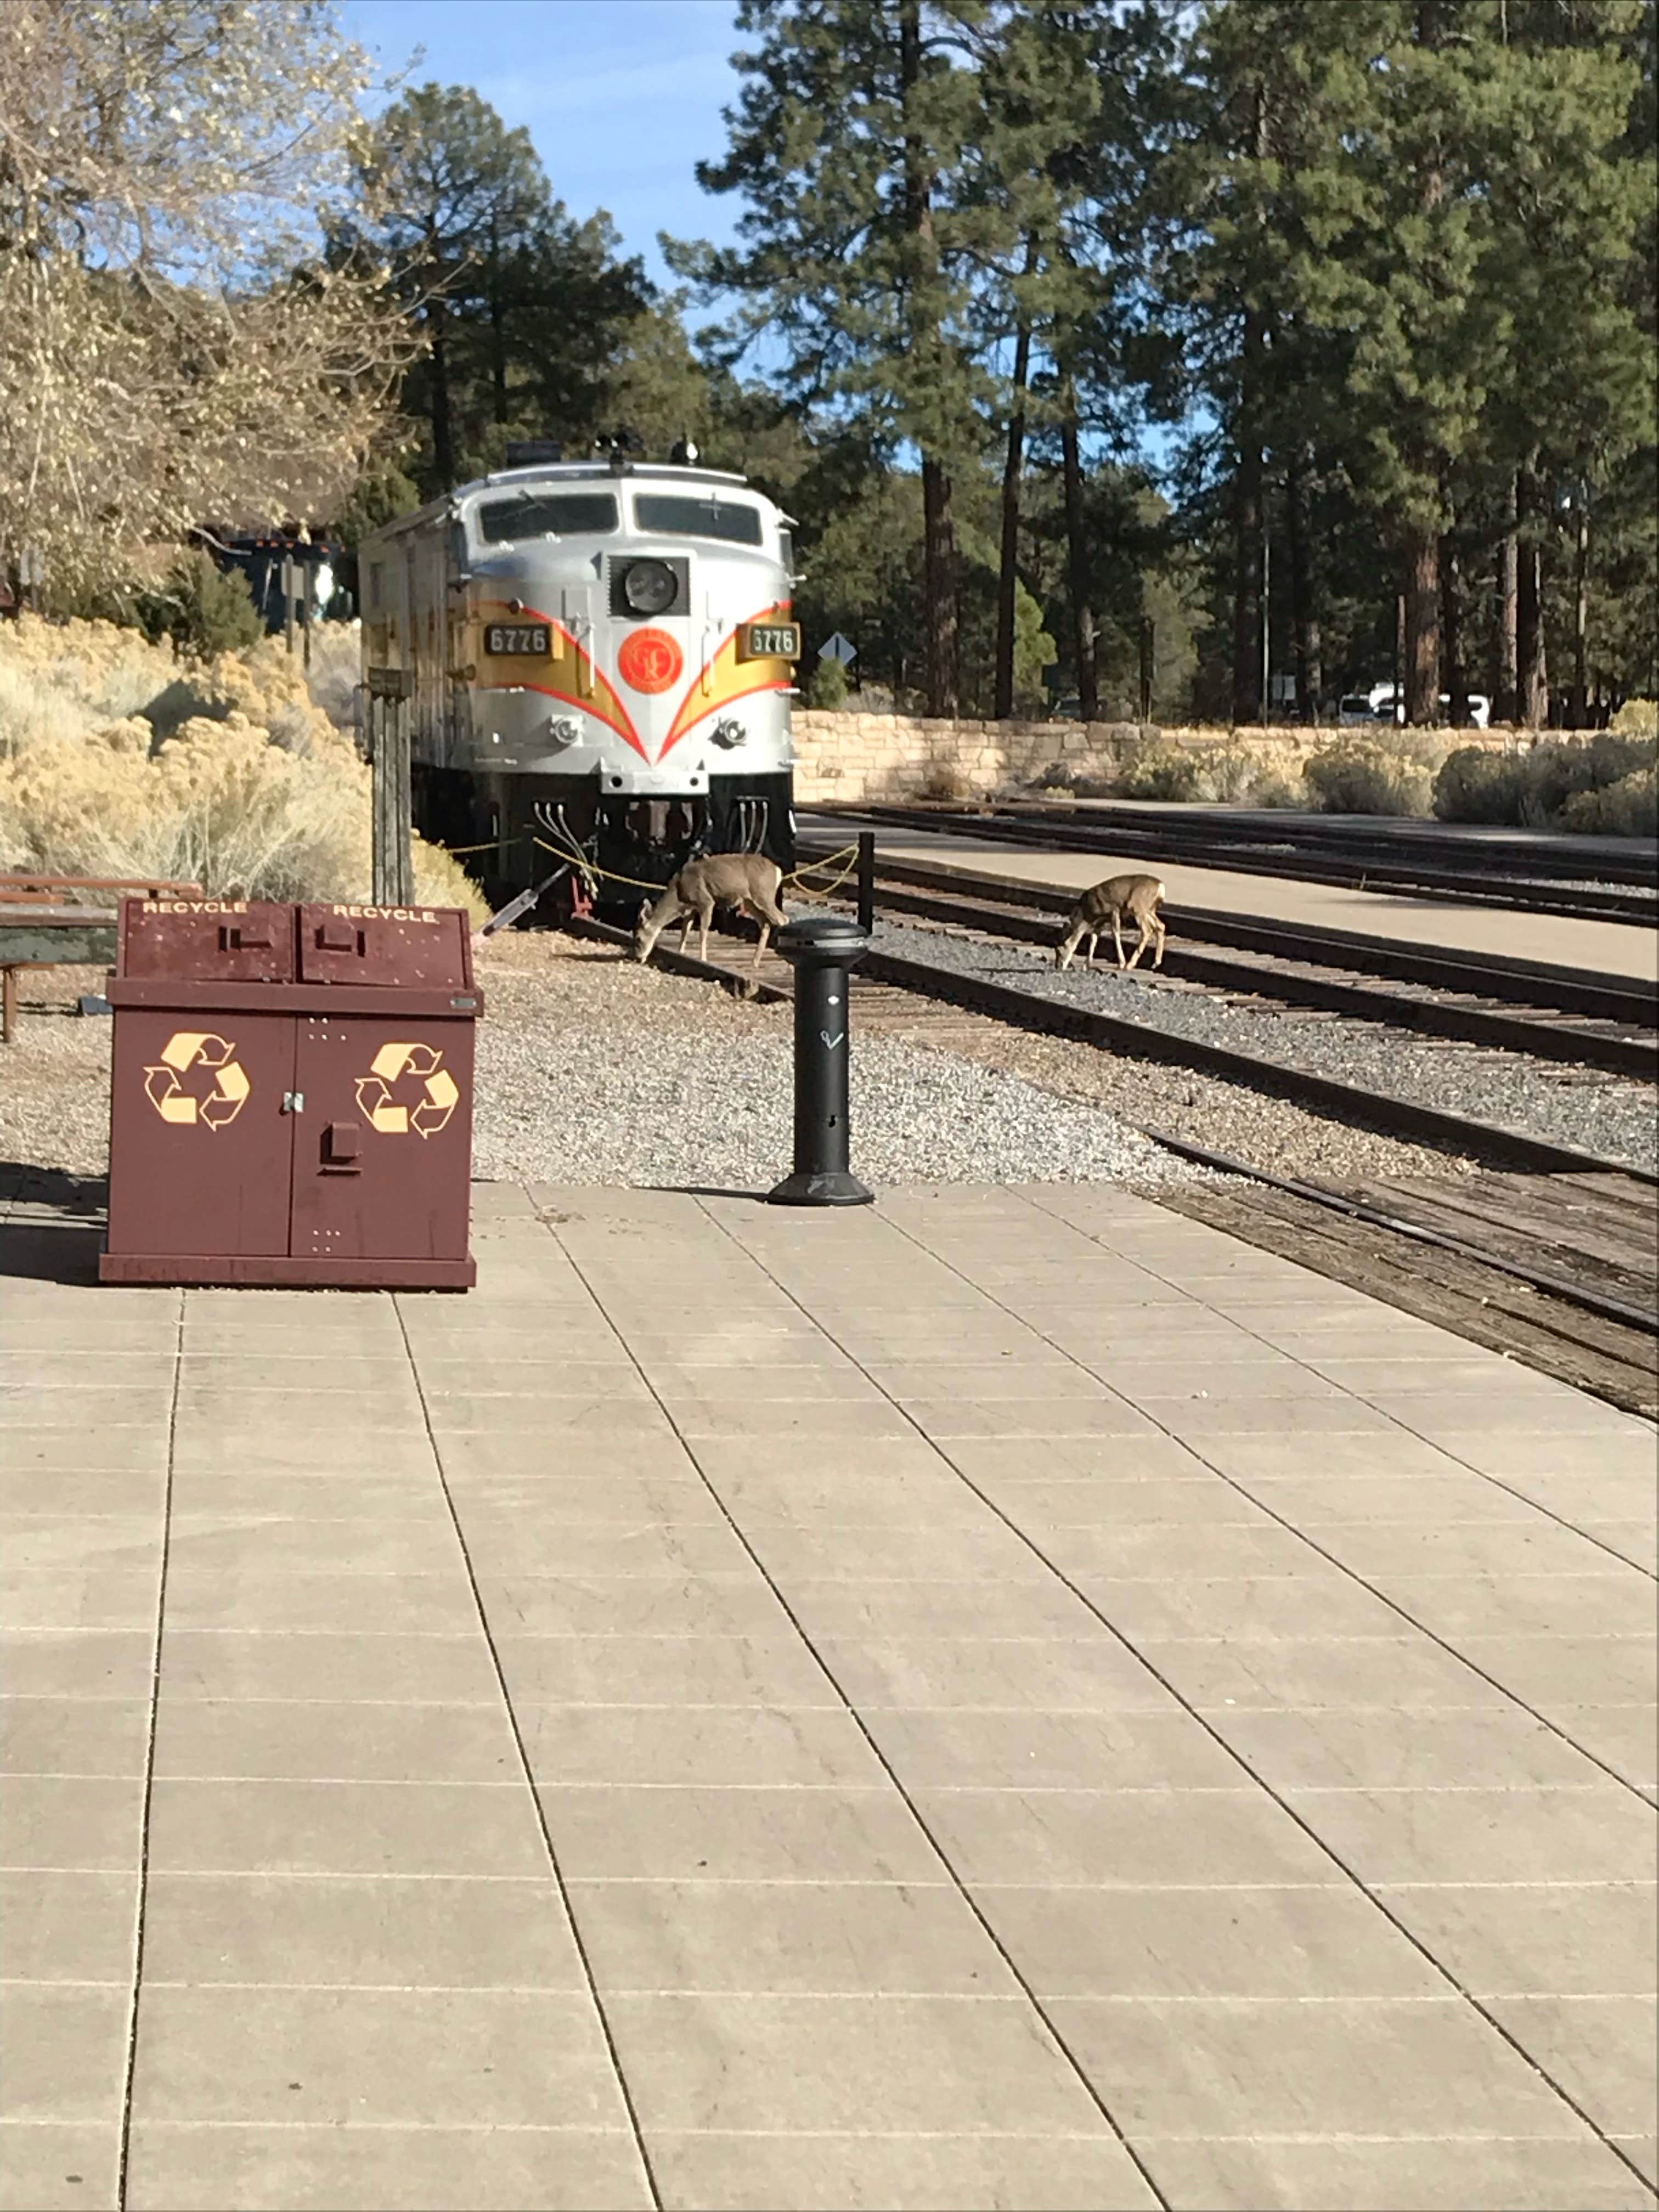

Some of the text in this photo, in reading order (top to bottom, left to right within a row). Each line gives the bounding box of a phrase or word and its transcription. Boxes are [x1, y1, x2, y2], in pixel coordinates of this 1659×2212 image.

[490, 629, 545, 652] 6776
[143, 902, 247, 913] RECYCLE
[333, 905, 438, 923] RECYCLE
